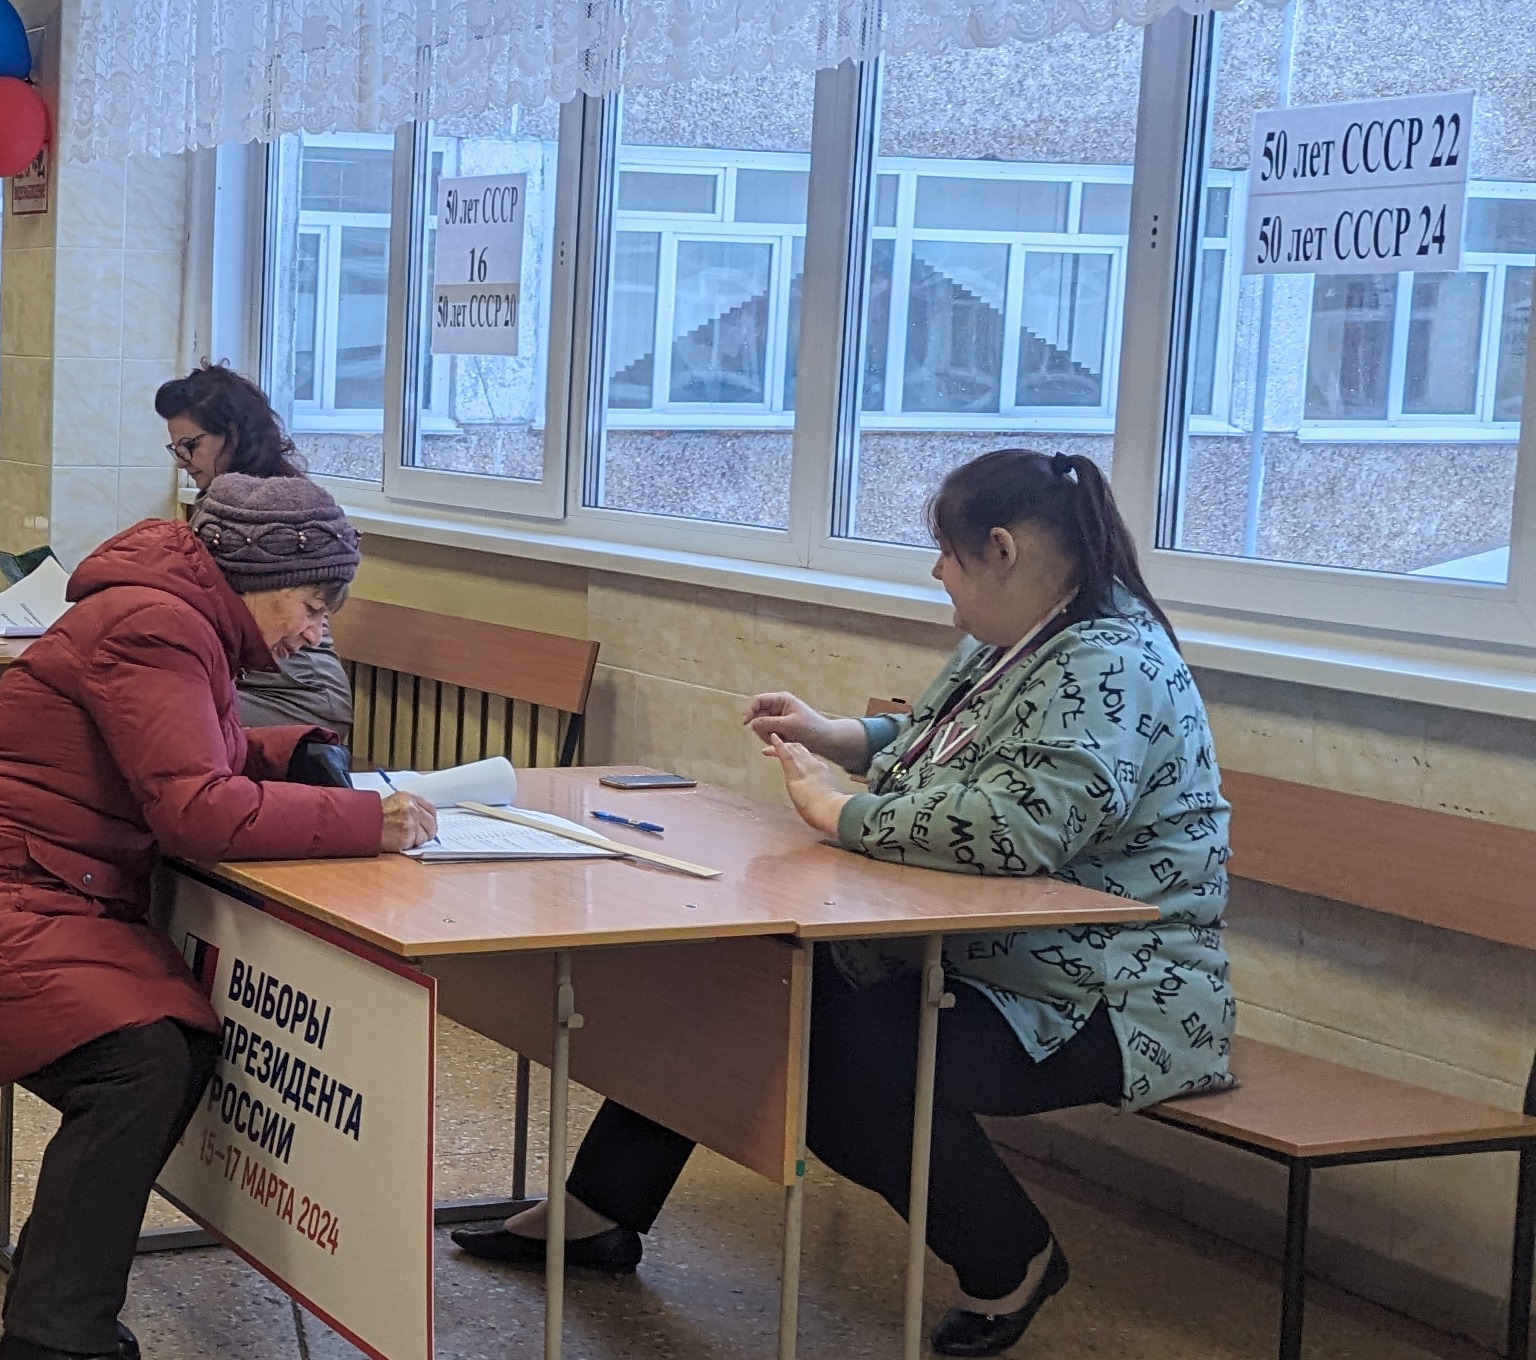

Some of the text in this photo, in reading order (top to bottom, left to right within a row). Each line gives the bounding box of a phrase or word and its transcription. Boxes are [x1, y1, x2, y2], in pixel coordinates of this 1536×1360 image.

[1261, 112, 1461, 181] 50 лет СССР 22
[445, 186, 518, 225] 50 лет СССР
[1257, 203, 1447, 264] 50 лет СССР 24
[468, 246, 489, 283] 16
[437, 294, 516, 328] 50 лет СССР 20
[227, 957, 332, 1050] ВЫБОРЫ
[221, 1015, 363, 1141] ПРЕЗИДЕНТА
[206, 1074, 296, 1165] РОССИИ
[240, 1154, 296, 1225] МАРТА
[296, 1195, 340, 1256] 2024
